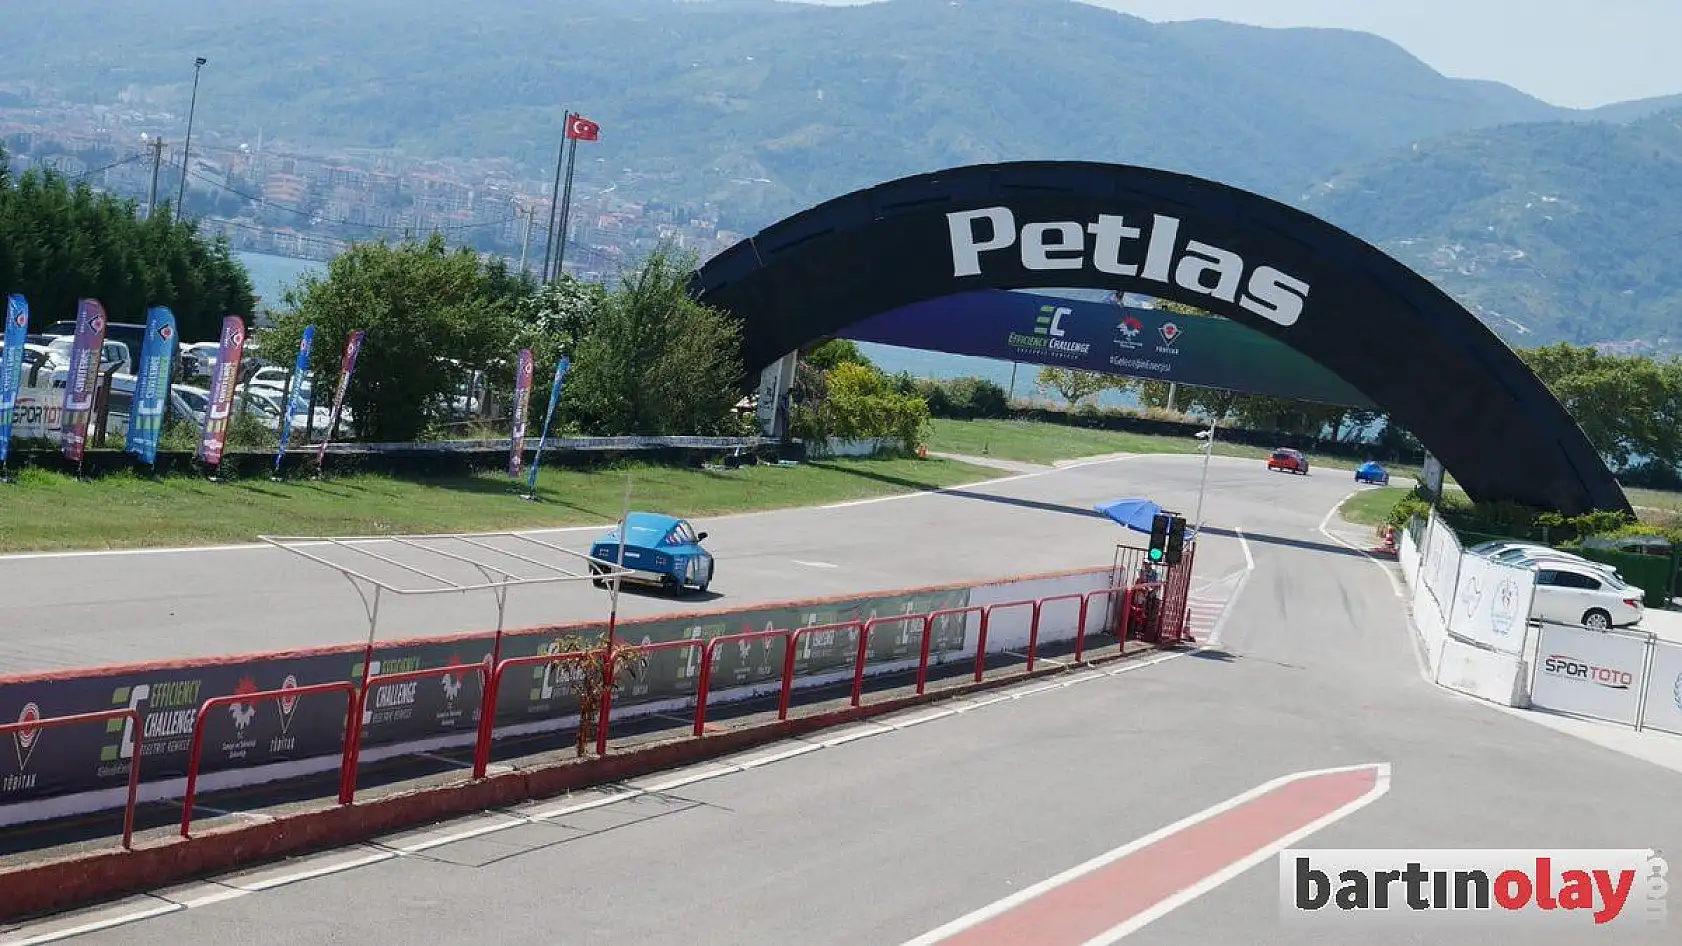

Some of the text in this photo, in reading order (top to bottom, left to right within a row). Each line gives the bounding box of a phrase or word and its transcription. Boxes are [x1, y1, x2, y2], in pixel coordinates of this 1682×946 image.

[946, 206, 1310, 327] Petlas
[150, 680, 201, 708] EFFICIENCY
[144, 708, 196, 738] CHALLENGE
